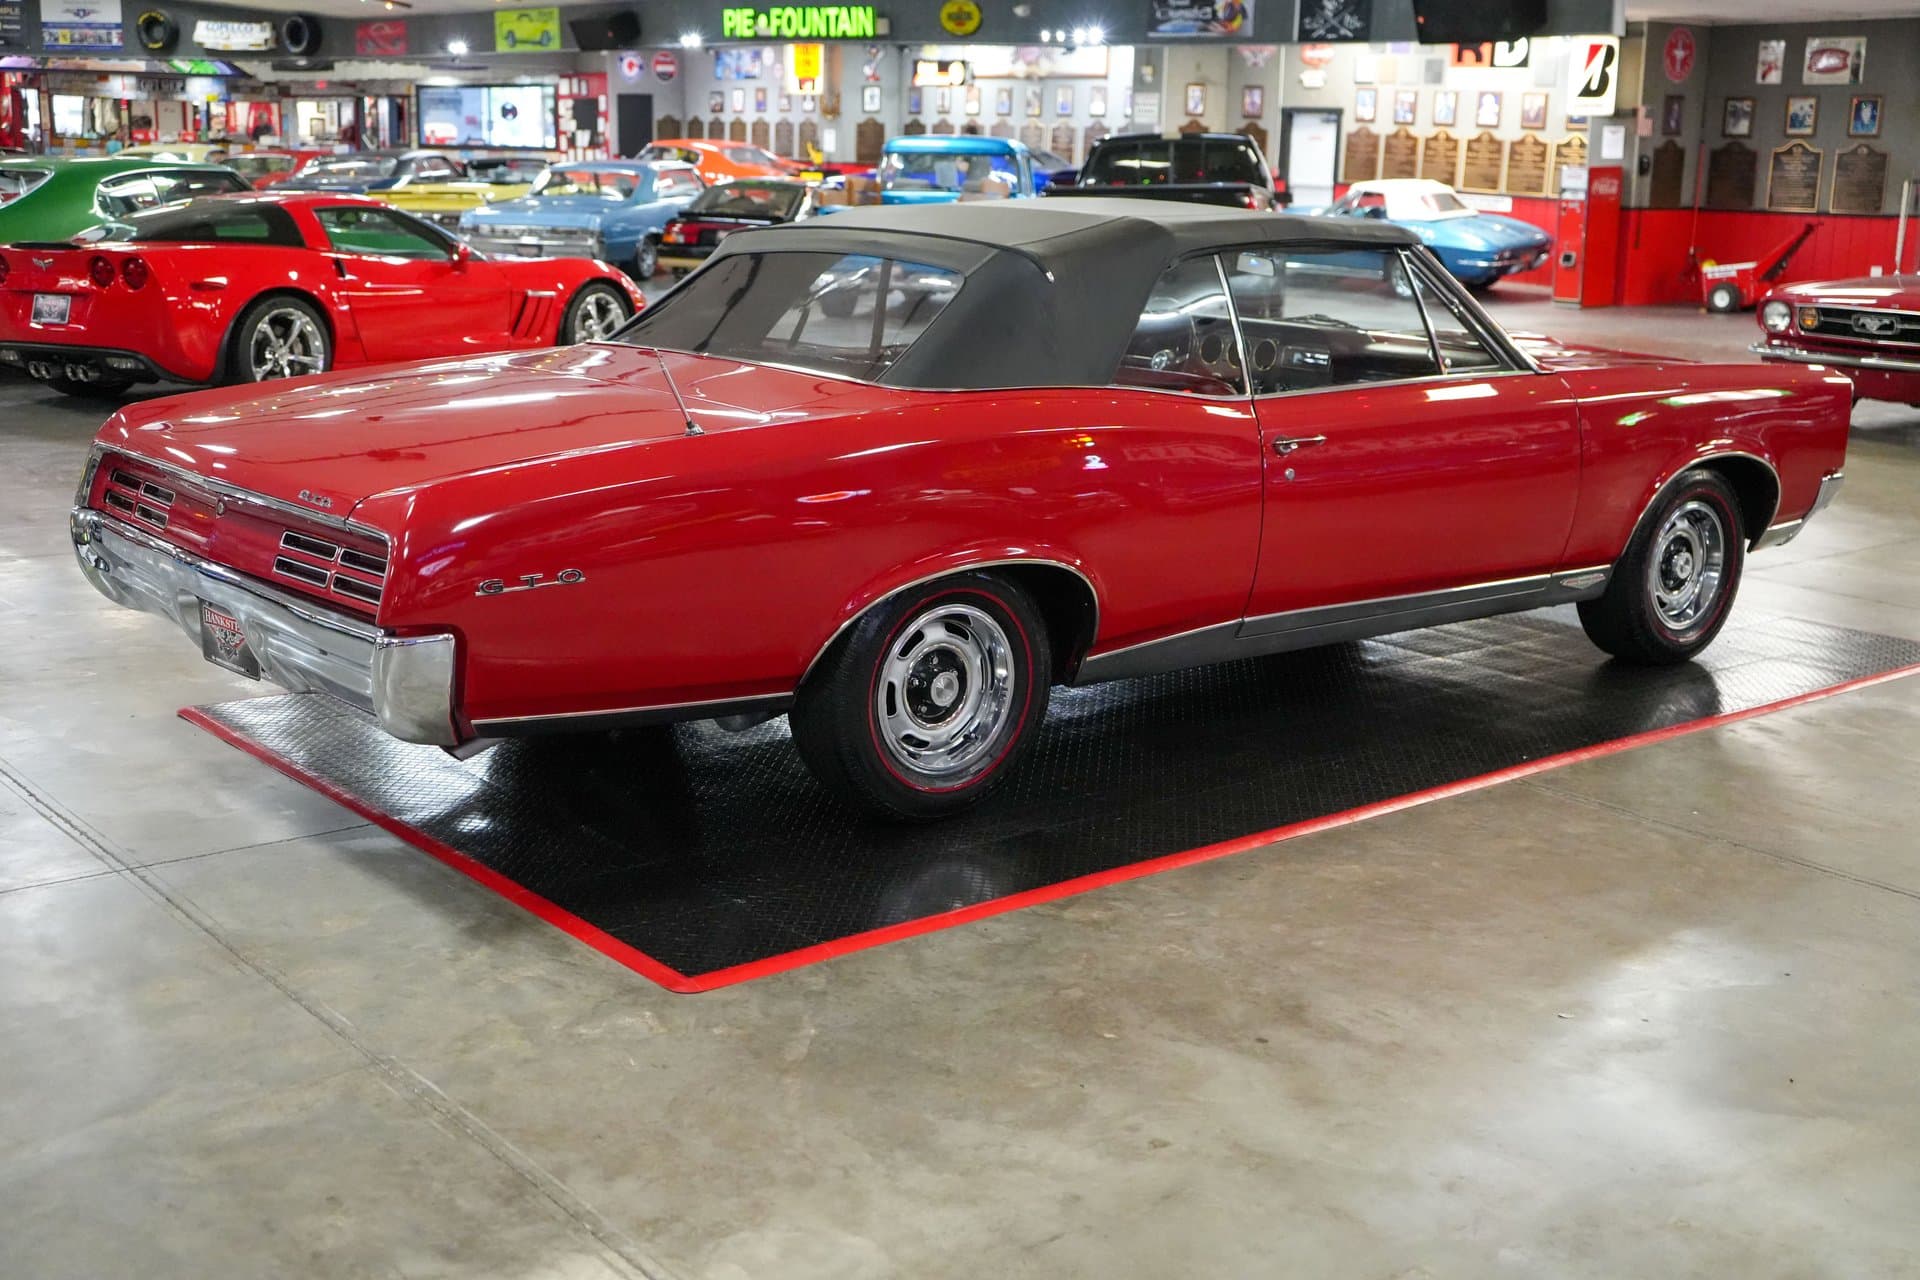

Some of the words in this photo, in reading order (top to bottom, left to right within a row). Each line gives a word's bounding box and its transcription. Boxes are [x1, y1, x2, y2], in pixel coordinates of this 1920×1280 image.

[723, 9, 755, 37] PIE
[769, 6, 875, 37] FOUNTAIN
[475, 568, 586, 596] GTO
